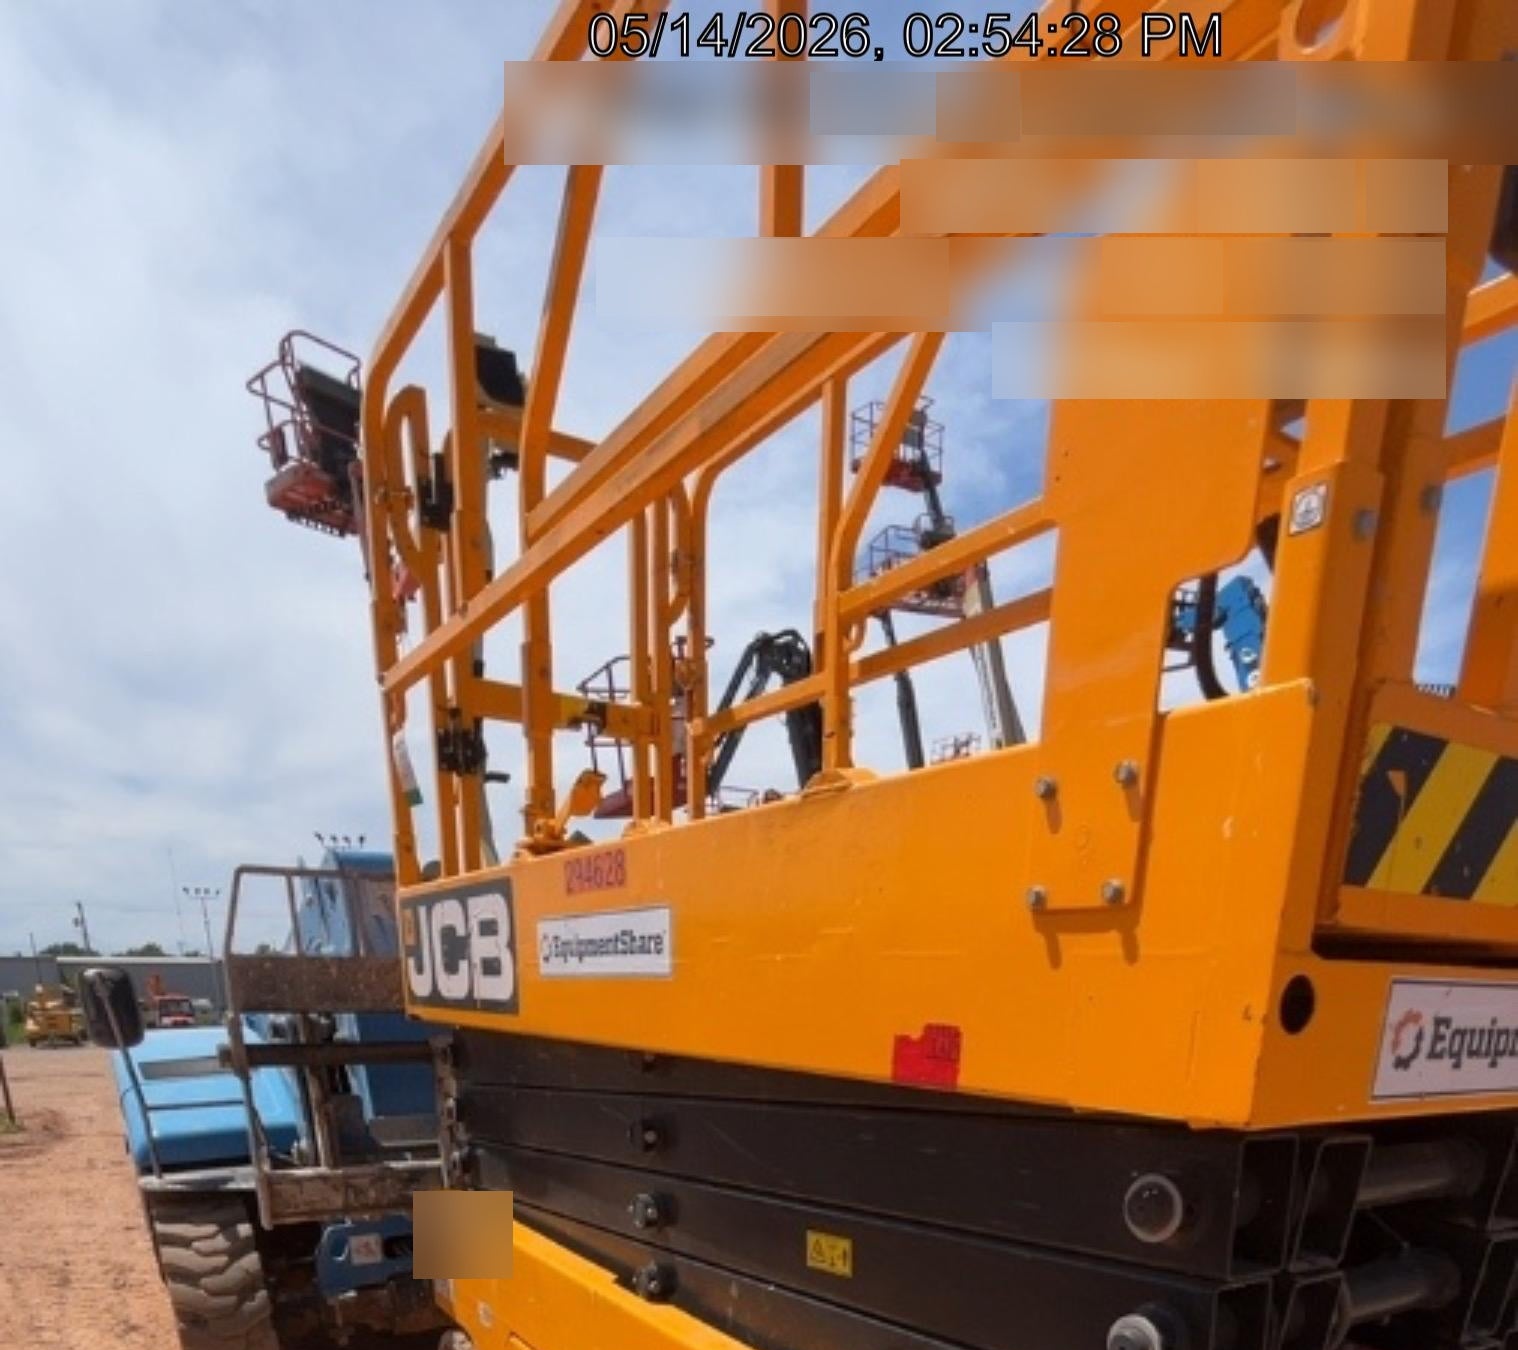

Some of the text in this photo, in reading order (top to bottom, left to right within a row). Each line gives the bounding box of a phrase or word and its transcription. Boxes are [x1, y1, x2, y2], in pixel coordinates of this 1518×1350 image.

[564, 848, 626, 896] 294628
[407, 893, 515, 1001] JCB
[552, 929, 664, 964] EquipmentShare
